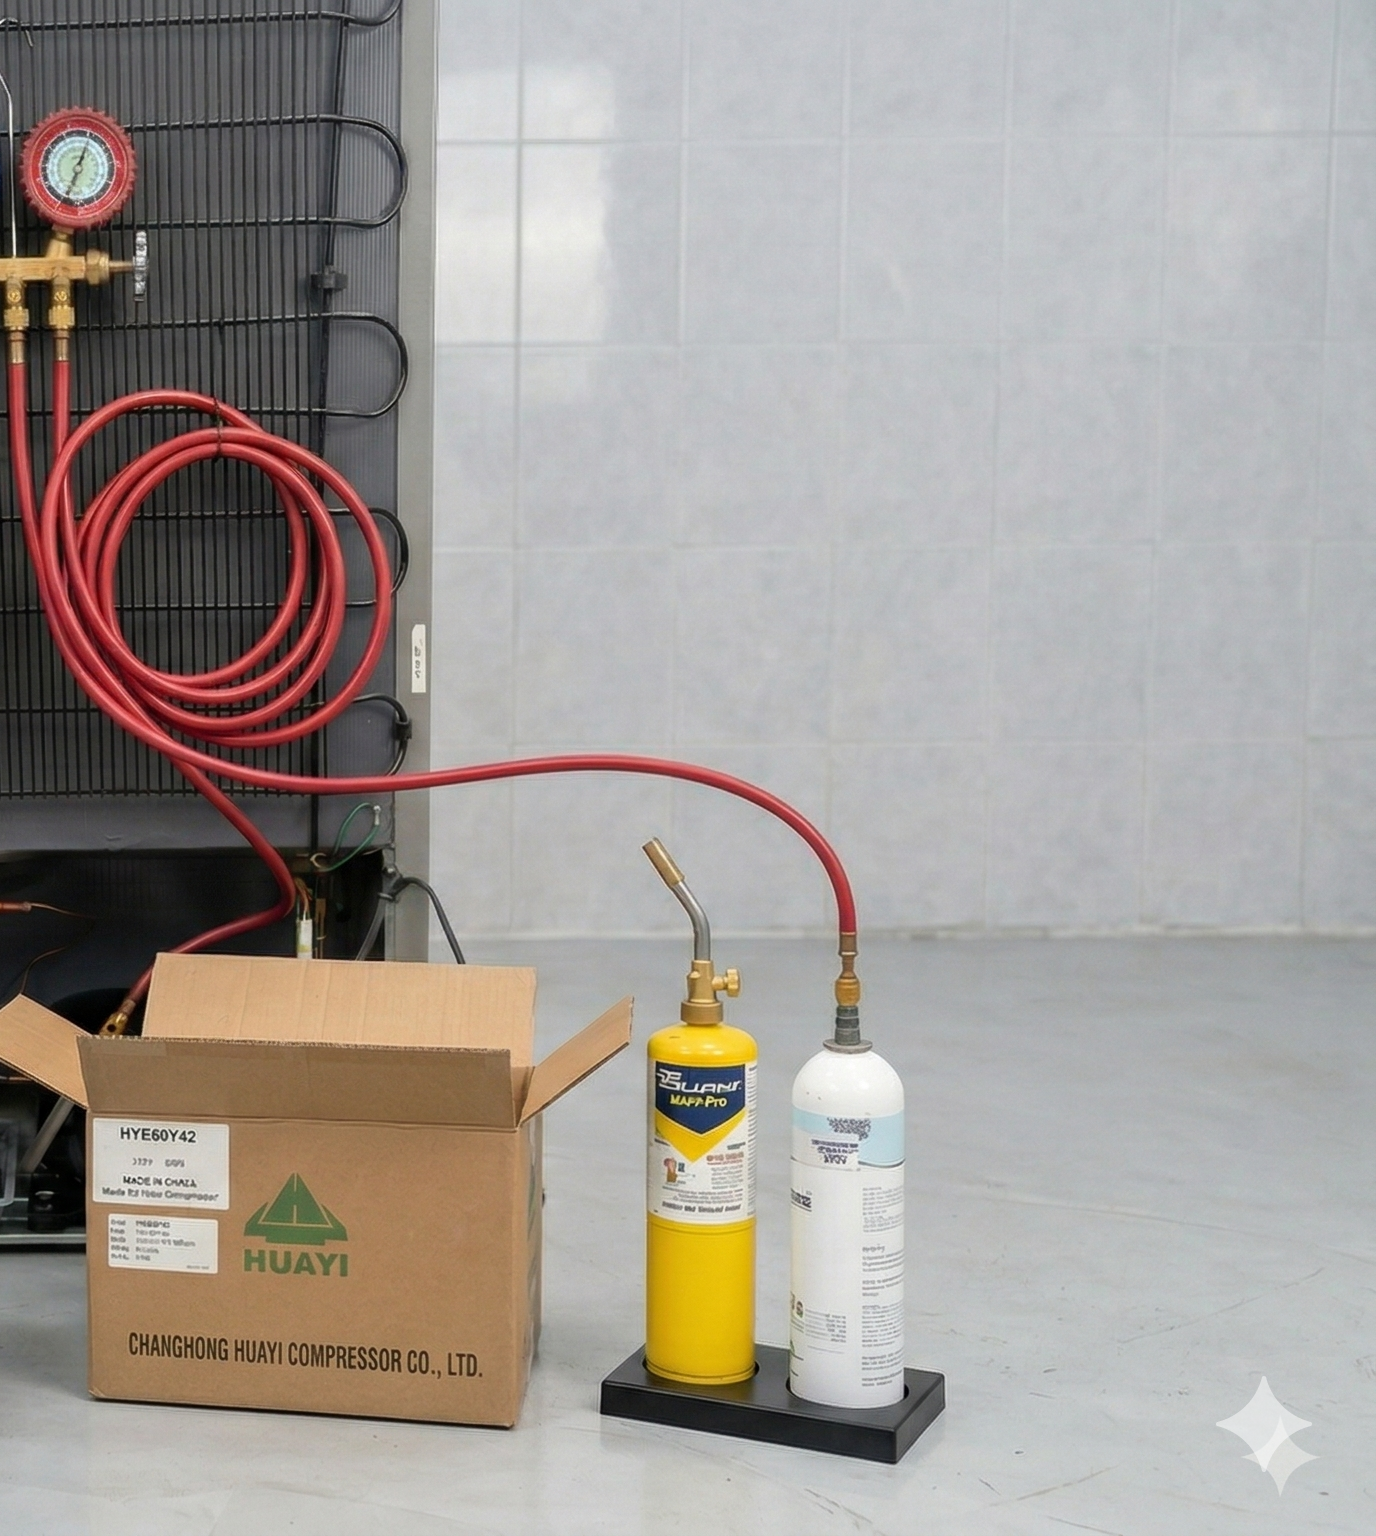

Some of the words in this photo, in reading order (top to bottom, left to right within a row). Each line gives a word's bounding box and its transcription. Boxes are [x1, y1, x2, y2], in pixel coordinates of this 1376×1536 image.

[120, 1126, 196, 1143] HYE60Y42
[244, 1248, 348, 1277] HUAYI
[129, 1332, 228, 1361] CHANGHONG
[234, 1339, 282, 1365] HUAYI
[288, 1342, 402, 1373] COMPRESSOR
[407, 1350, 442, 1379] CO.,
[447, 1352, 483, 1377] LTD.
